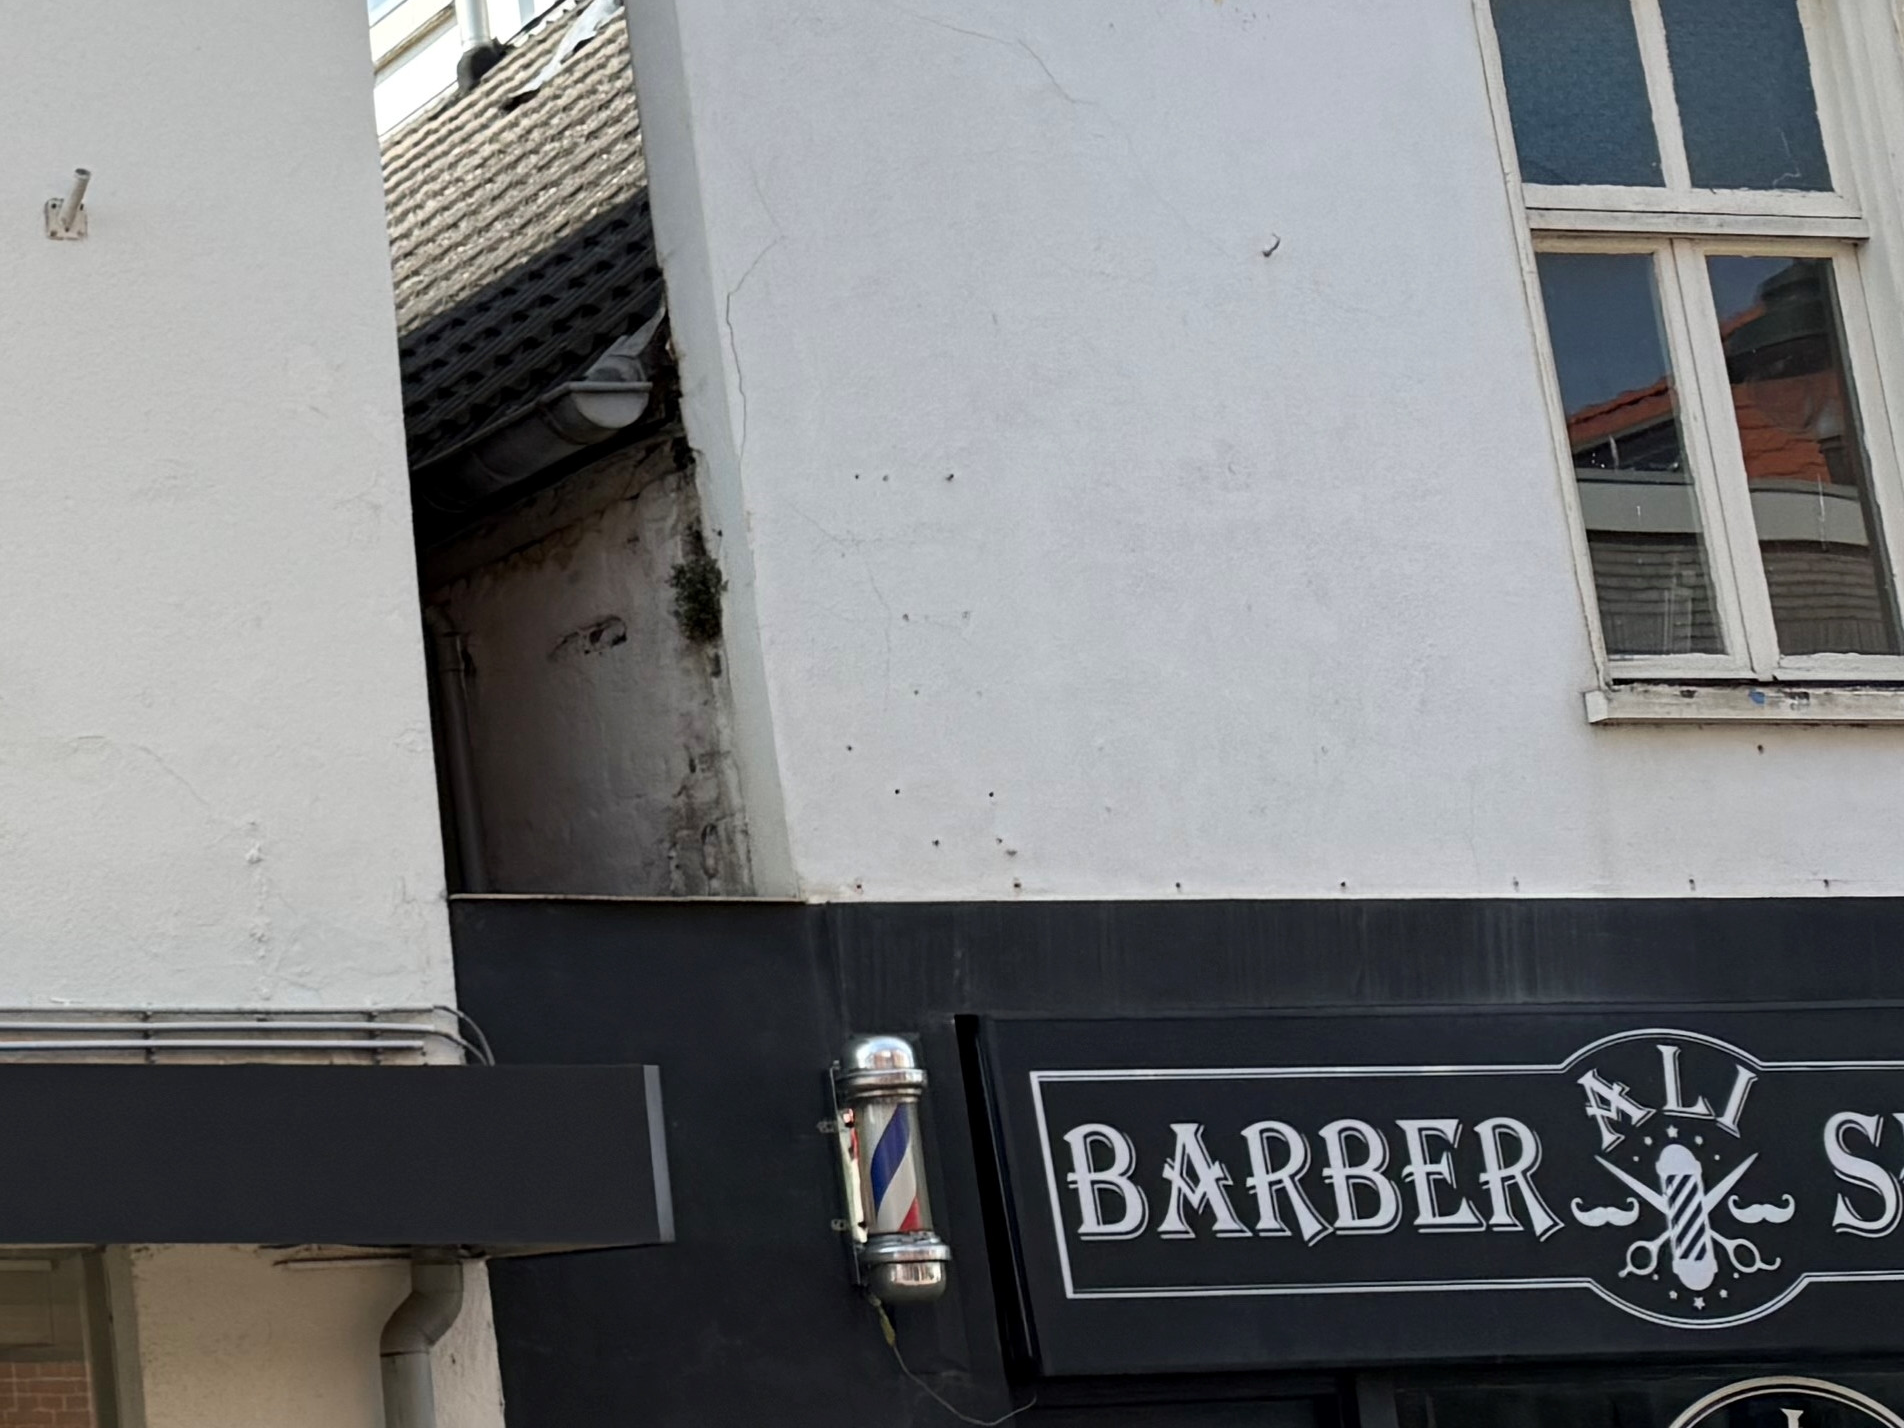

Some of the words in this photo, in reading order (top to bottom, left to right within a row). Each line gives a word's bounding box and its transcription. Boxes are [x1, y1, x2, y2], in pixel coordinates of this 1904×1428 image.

[1575, 1044, 1760, 1151] ALI
[1063, 1116, 1565, 1245] BARBER
[1823, 1110, 1904, 1239] S
